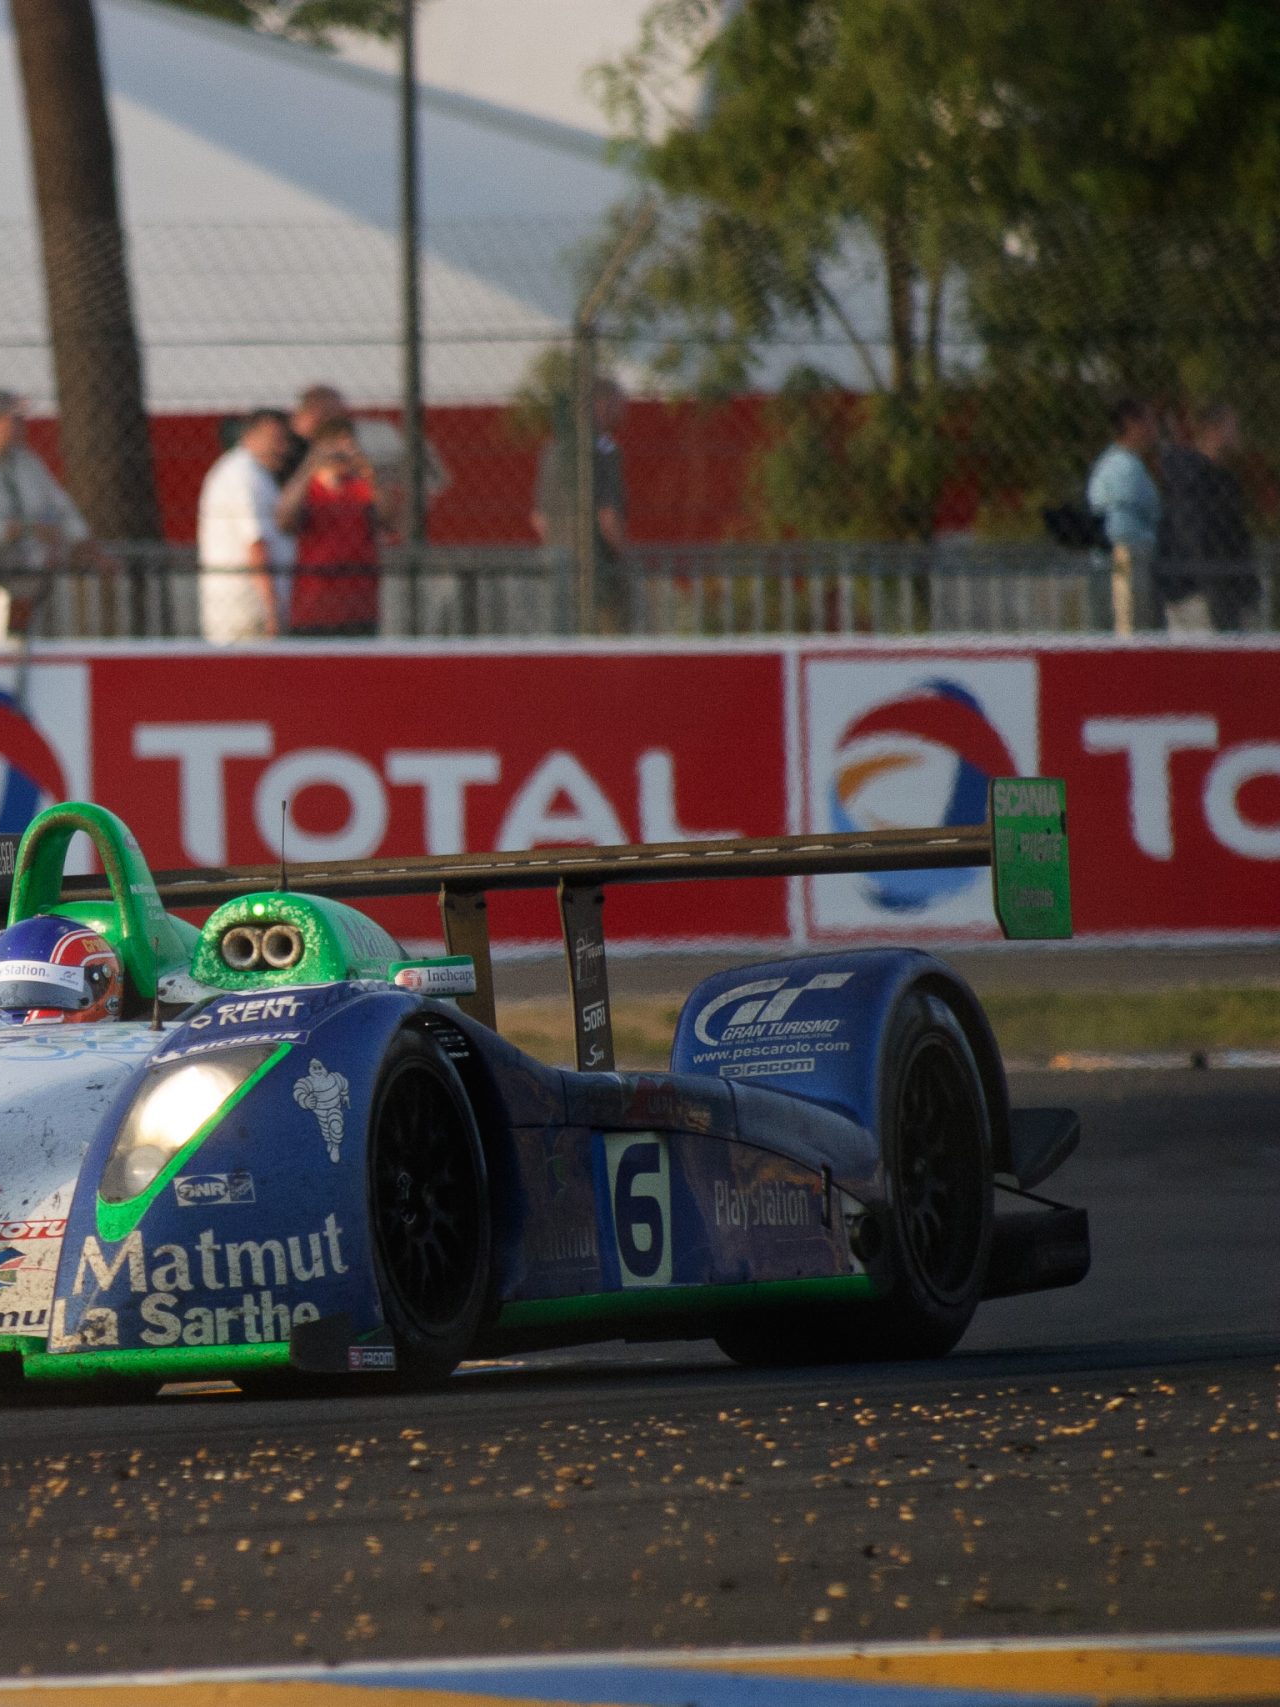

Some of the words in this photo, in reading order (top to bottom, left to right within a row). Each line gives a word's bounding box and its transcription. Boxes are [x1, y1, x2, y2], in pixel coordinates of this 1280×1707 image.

[132, 722, 747, 868] TOTAL
[220, 1002, 304, 1026] KENT
[721, 1024, 767, 1042] GRAN
[768, 1019, 841, 1036] TURISMO
[185, 1031, 301, 1054] MICHELIN
[692, 1041, 850, 1064] www.pescarolo.com
[747, 1060, 812, 1075] FACOM
[177, 1182, 228, 1198] SNR
[614, 1142, 664, 1278] 6
[72, 1212, 349, 1294] Matmut
